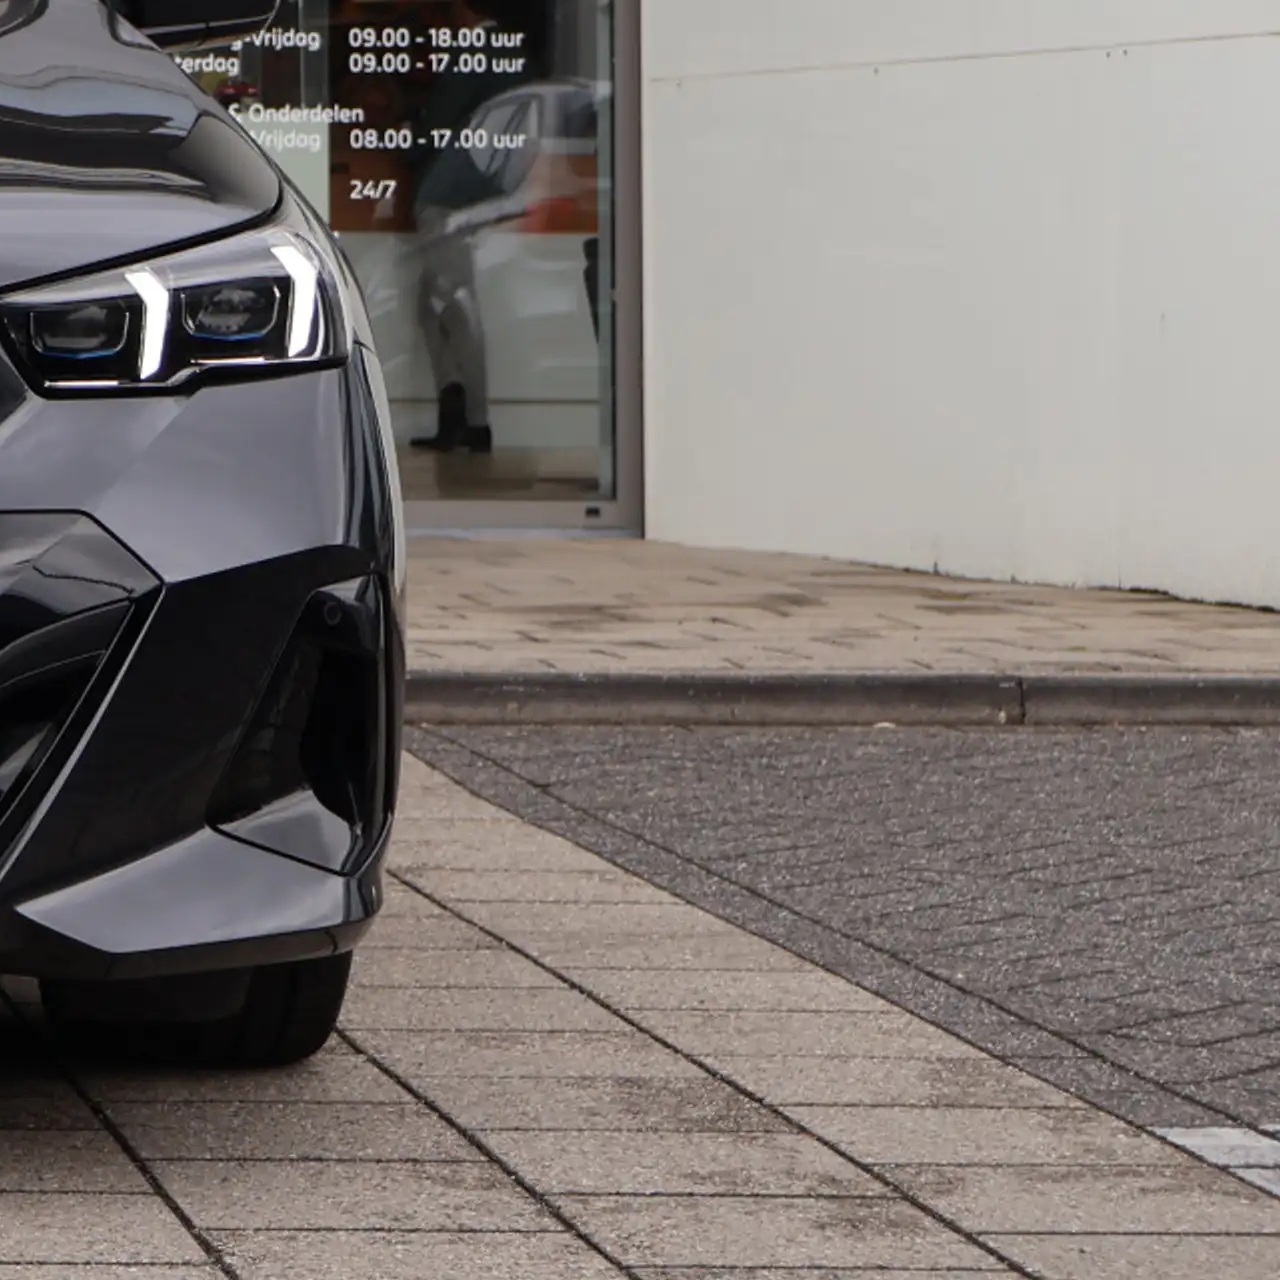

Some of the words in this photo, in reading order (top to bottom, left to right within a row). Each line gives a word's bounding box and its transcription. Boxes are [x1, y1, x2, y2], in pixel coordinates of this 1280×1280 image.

[349, 28, 410, 48] 09.00
[428, 28, 485, 48] 18.00
[491, 33, 524, 48] uur
[349, 53, 410, 73] 09.00
[492, 58, 525, 73] uur
[248, 103, 364, 123] Onderdelen
[350, 129, 412, 149] 08.00
[493, 134, 526, 149] uur
[350, 180, 397, 200] 24/7
